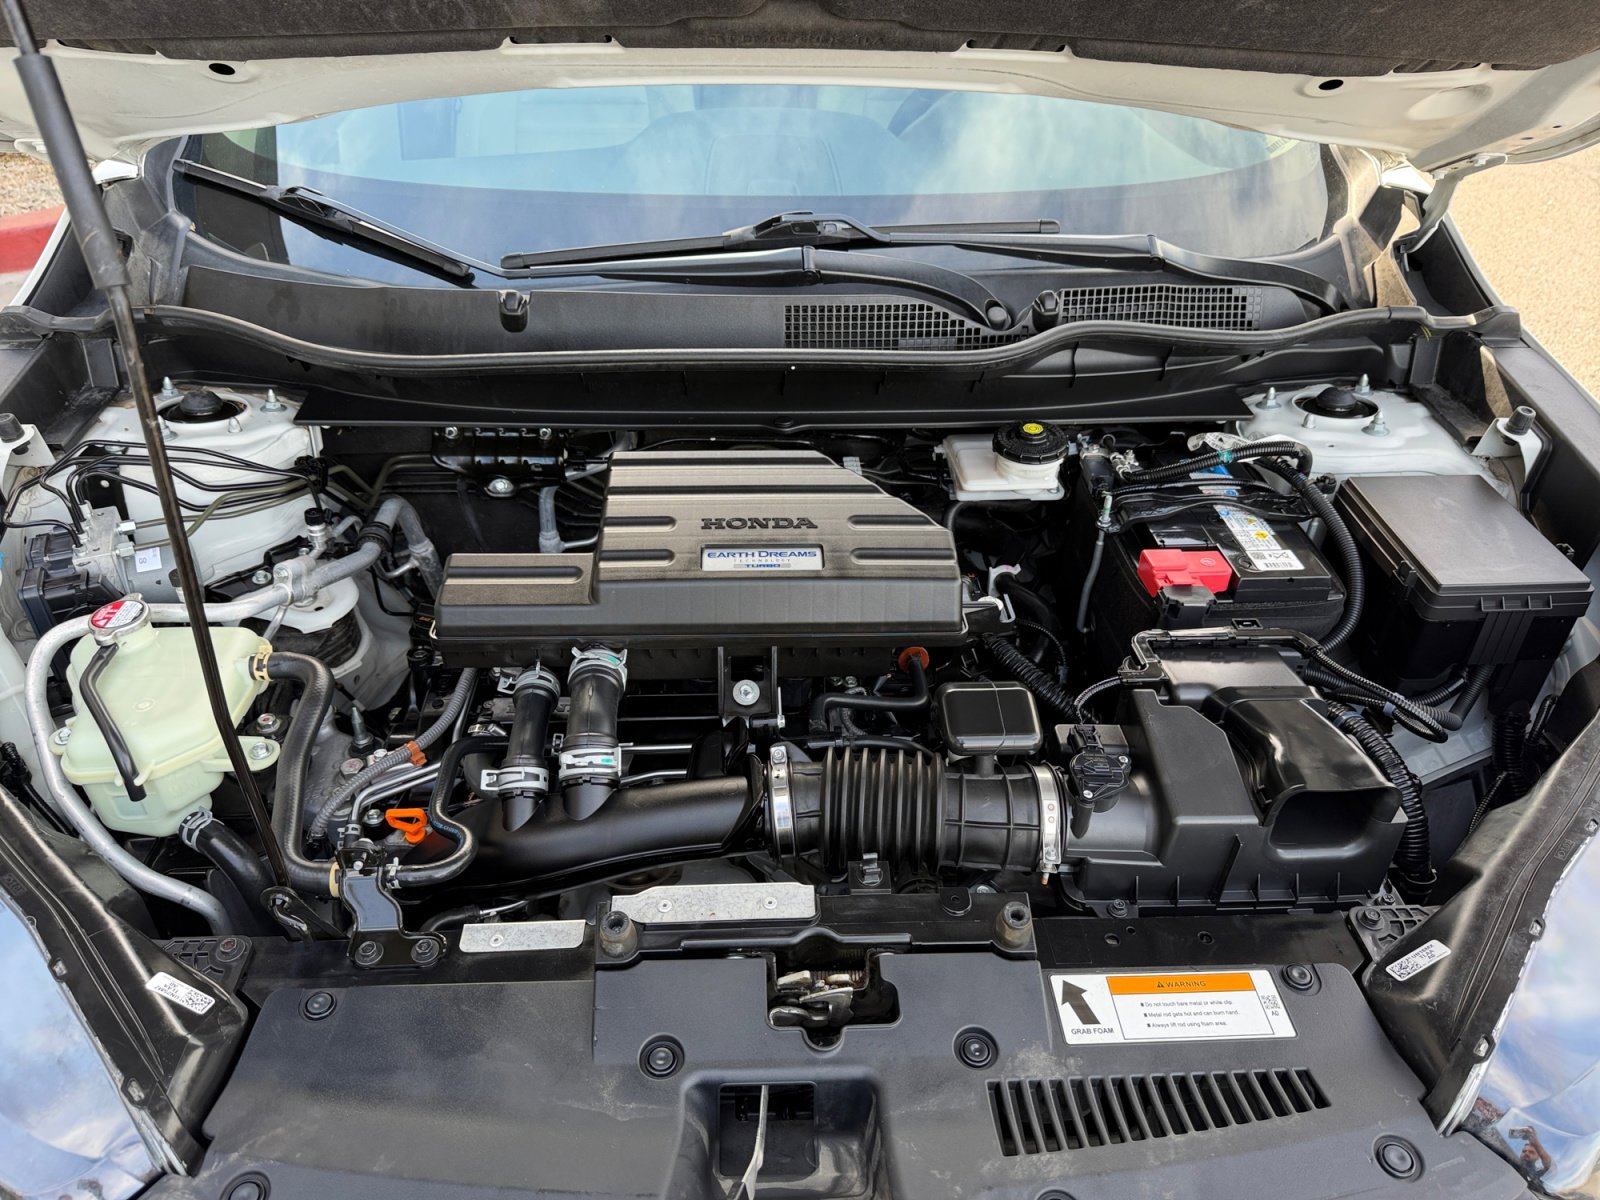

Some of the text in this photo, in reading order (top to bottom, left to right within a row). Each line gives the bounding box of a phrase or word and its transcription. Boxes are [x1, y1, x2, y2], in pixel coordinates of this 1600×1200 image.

[701, 517, 818, 530] HONDA
[707, 550, 817, 559] EARTH DREAMS
[1166, 980, 1207, 988] WARNING
